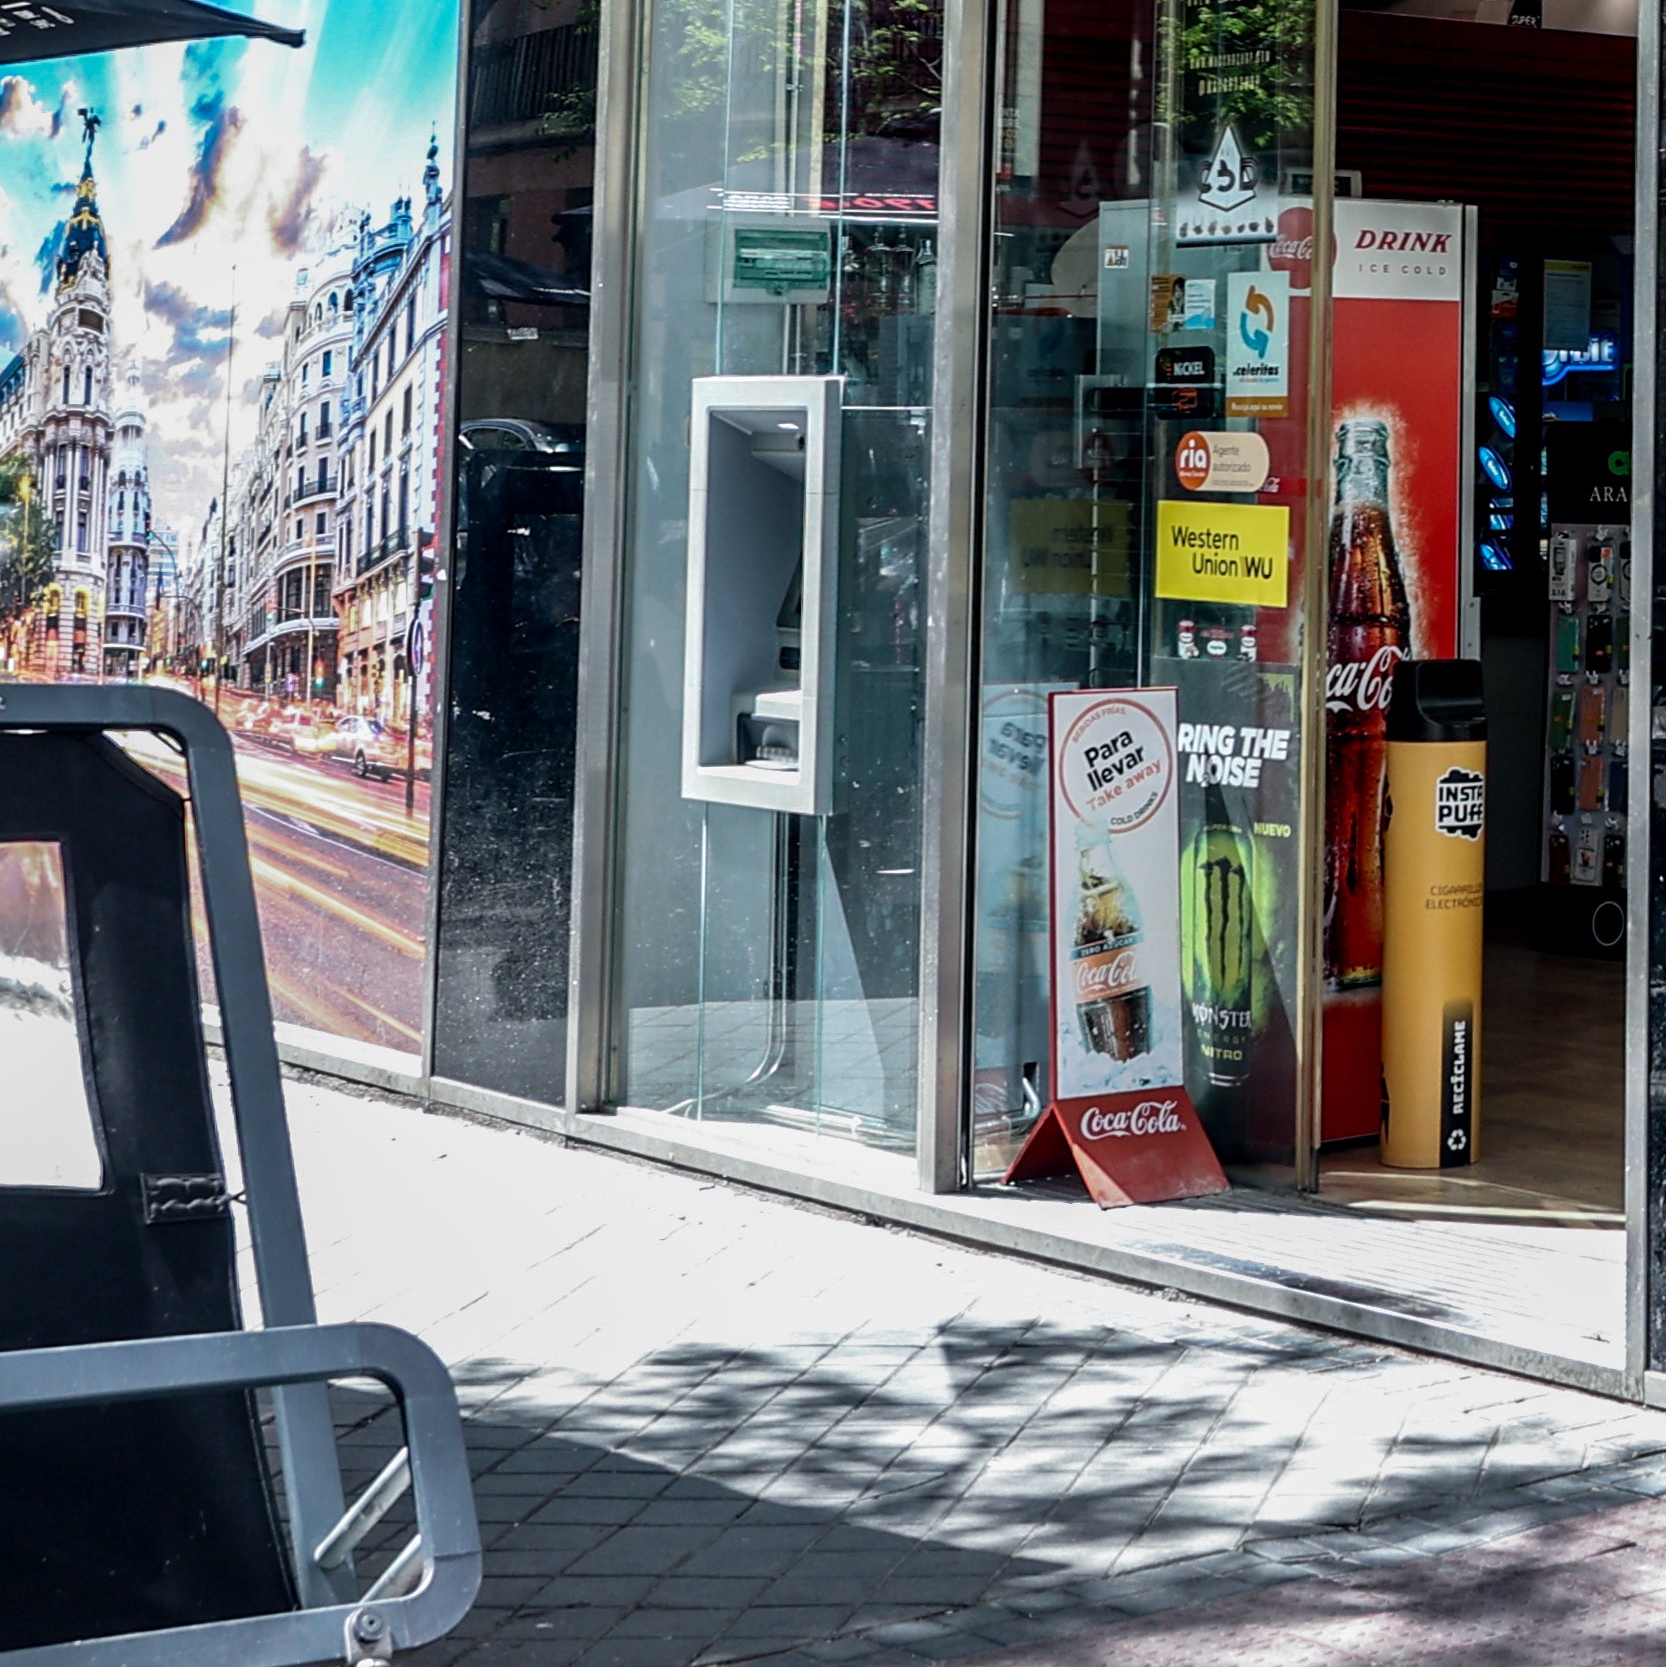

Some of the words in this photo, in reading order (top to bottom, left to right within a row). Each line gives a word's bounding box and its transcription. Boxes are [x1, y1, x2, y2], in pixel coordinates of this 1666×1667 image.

[1354, 229, 1453, 254] DRINK
[1359, 263, 1390, 273] ICE
[1401, 265, 1447, 275] COLD
[1179, 438, 1207, 469] ria
[1171, 525, 1239, 551] Western
[1192, 551, 1238, 577] Union
[1241, 556, 1273, 580] WU
[1084, 730, 1133, 769] Para
[1240, 727, 1291, 760] THE
[1087, 745, 1144, 792] llevar
[1086, 784, 1123, 811] Take
[1124, 759, 1162, 789] away
[1253, 822, 1292, 838] NUEVO
[1201, 1044, 1243, 1061] NITRO
[1081, 1100, 1179, 1141] Coca-Cola
